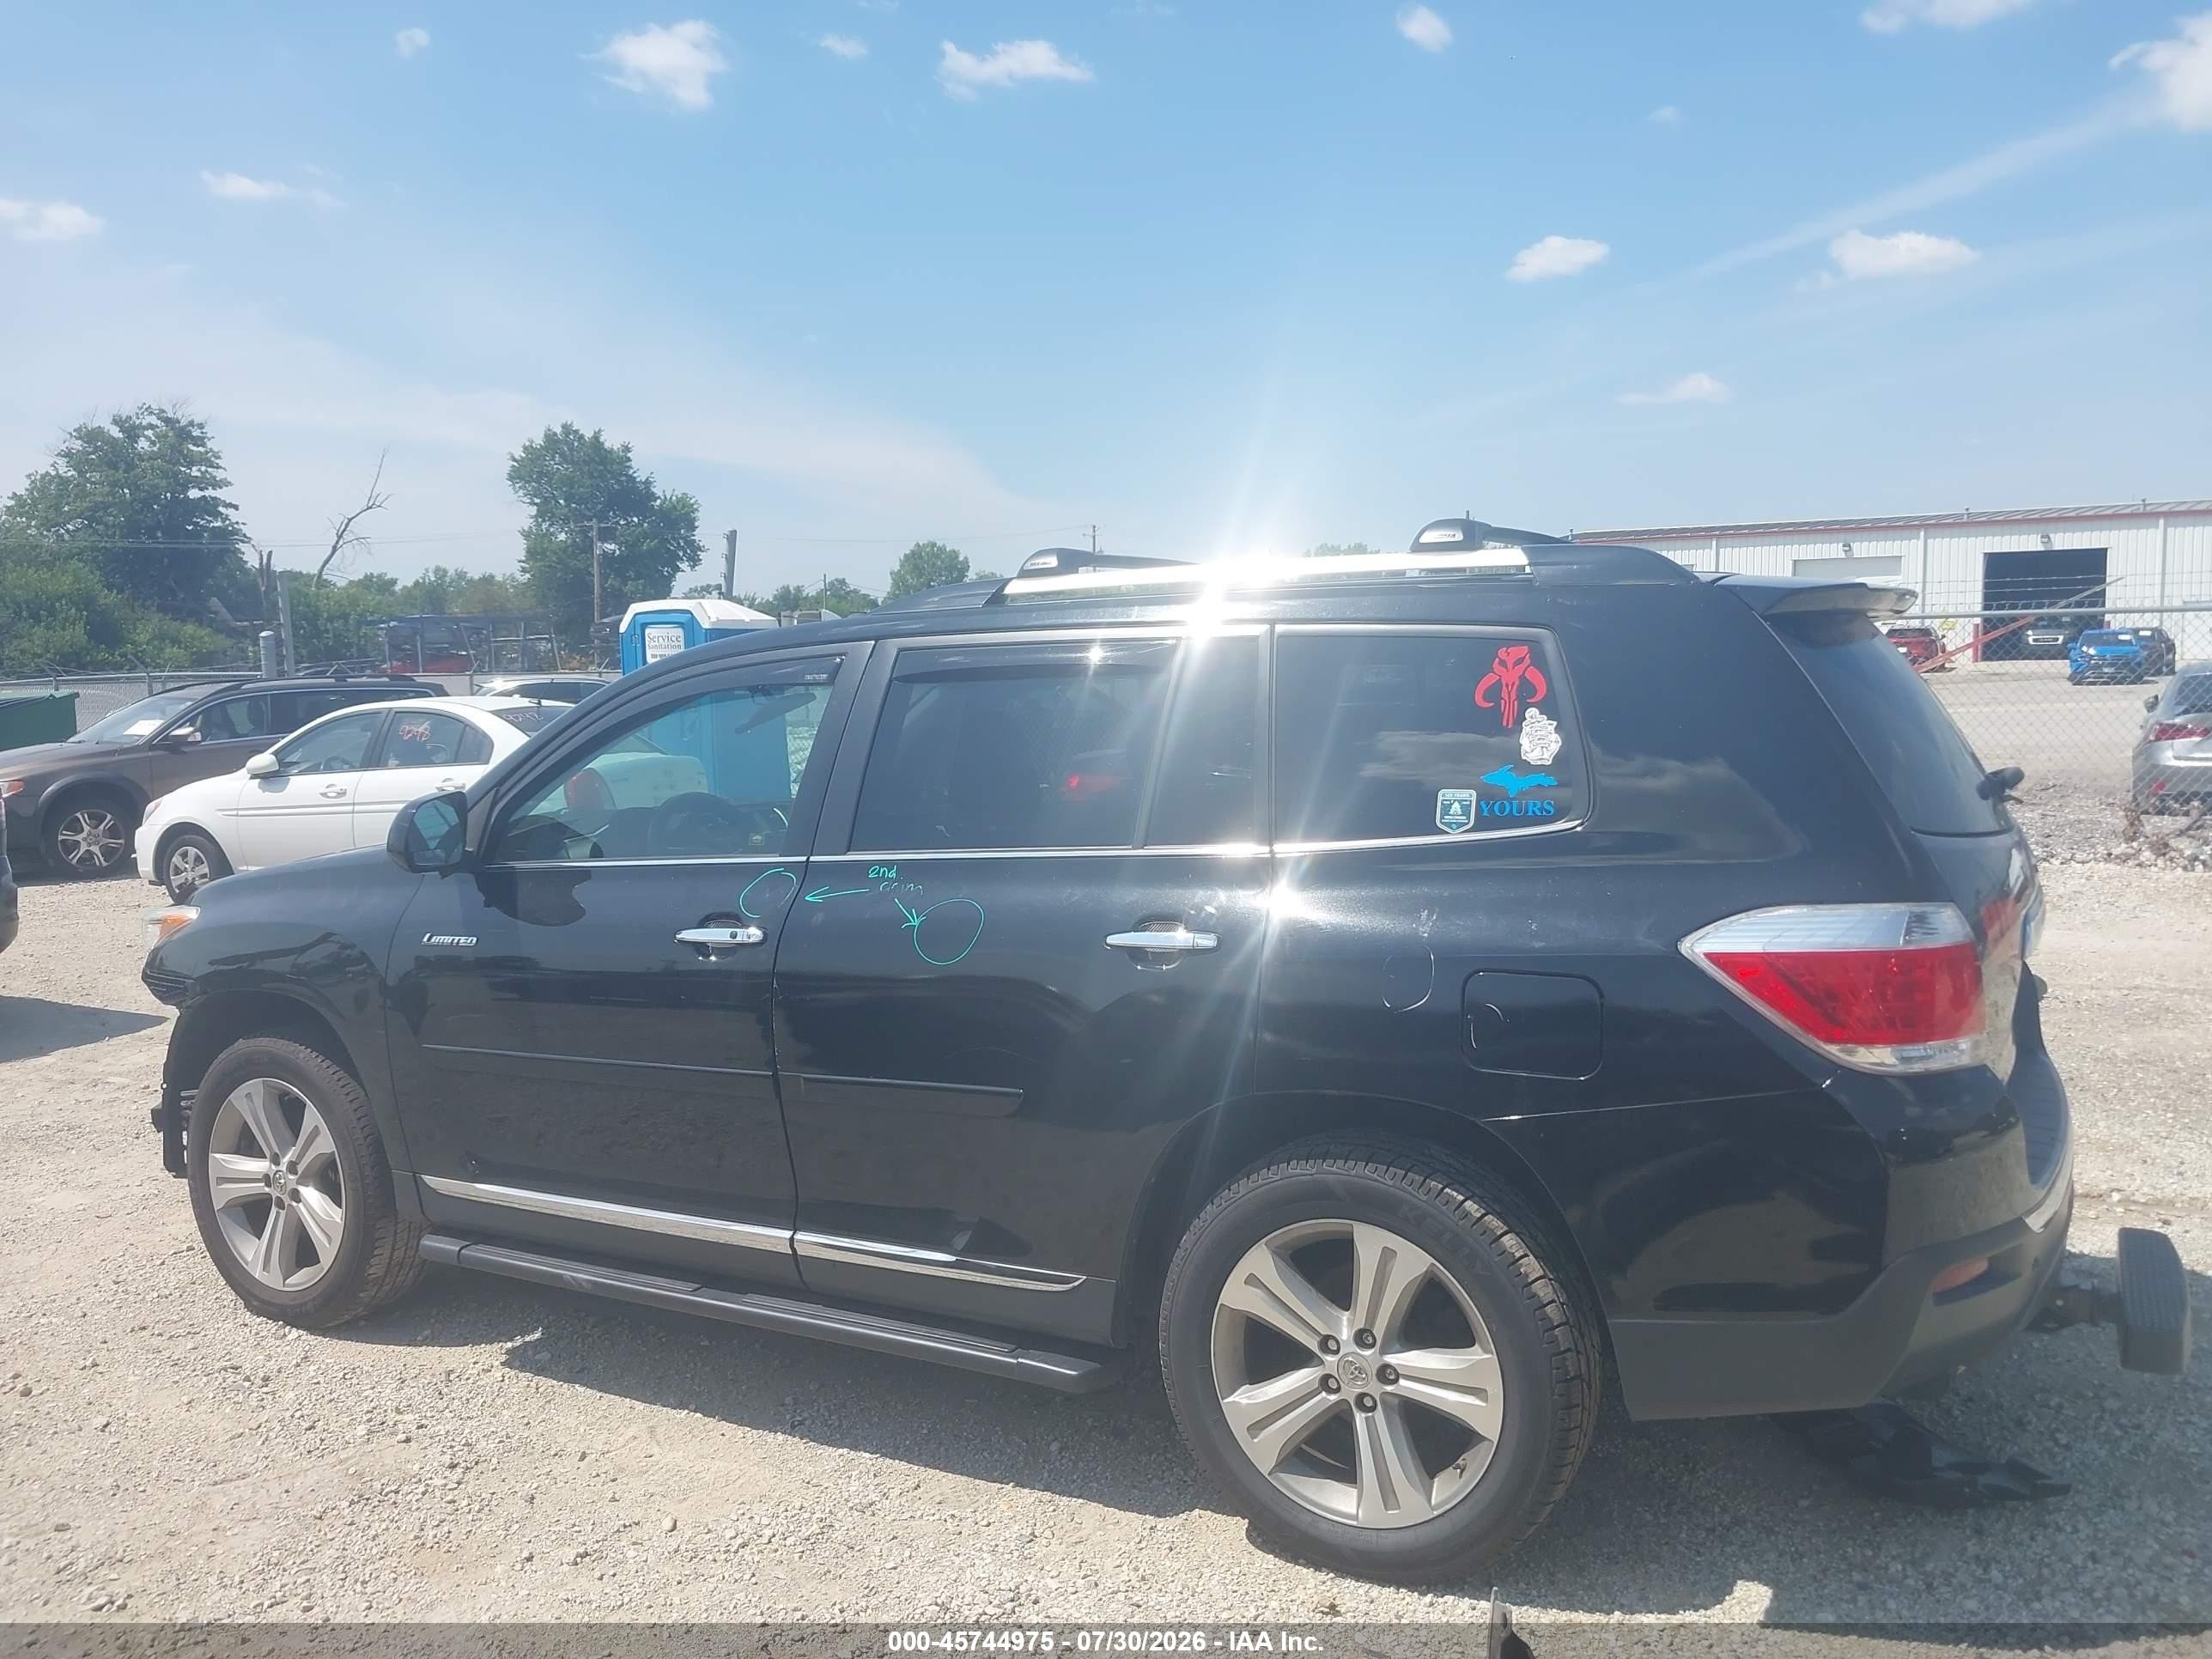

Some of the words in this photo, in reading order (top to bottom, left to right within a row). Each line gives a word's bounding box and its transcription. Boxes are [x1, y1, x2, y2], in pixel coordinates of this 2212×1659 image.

[647, 632, 682, 643] Service
[1480, 800, 1554, 816] YOURS
[868, 864, 897, 879] 2nd
